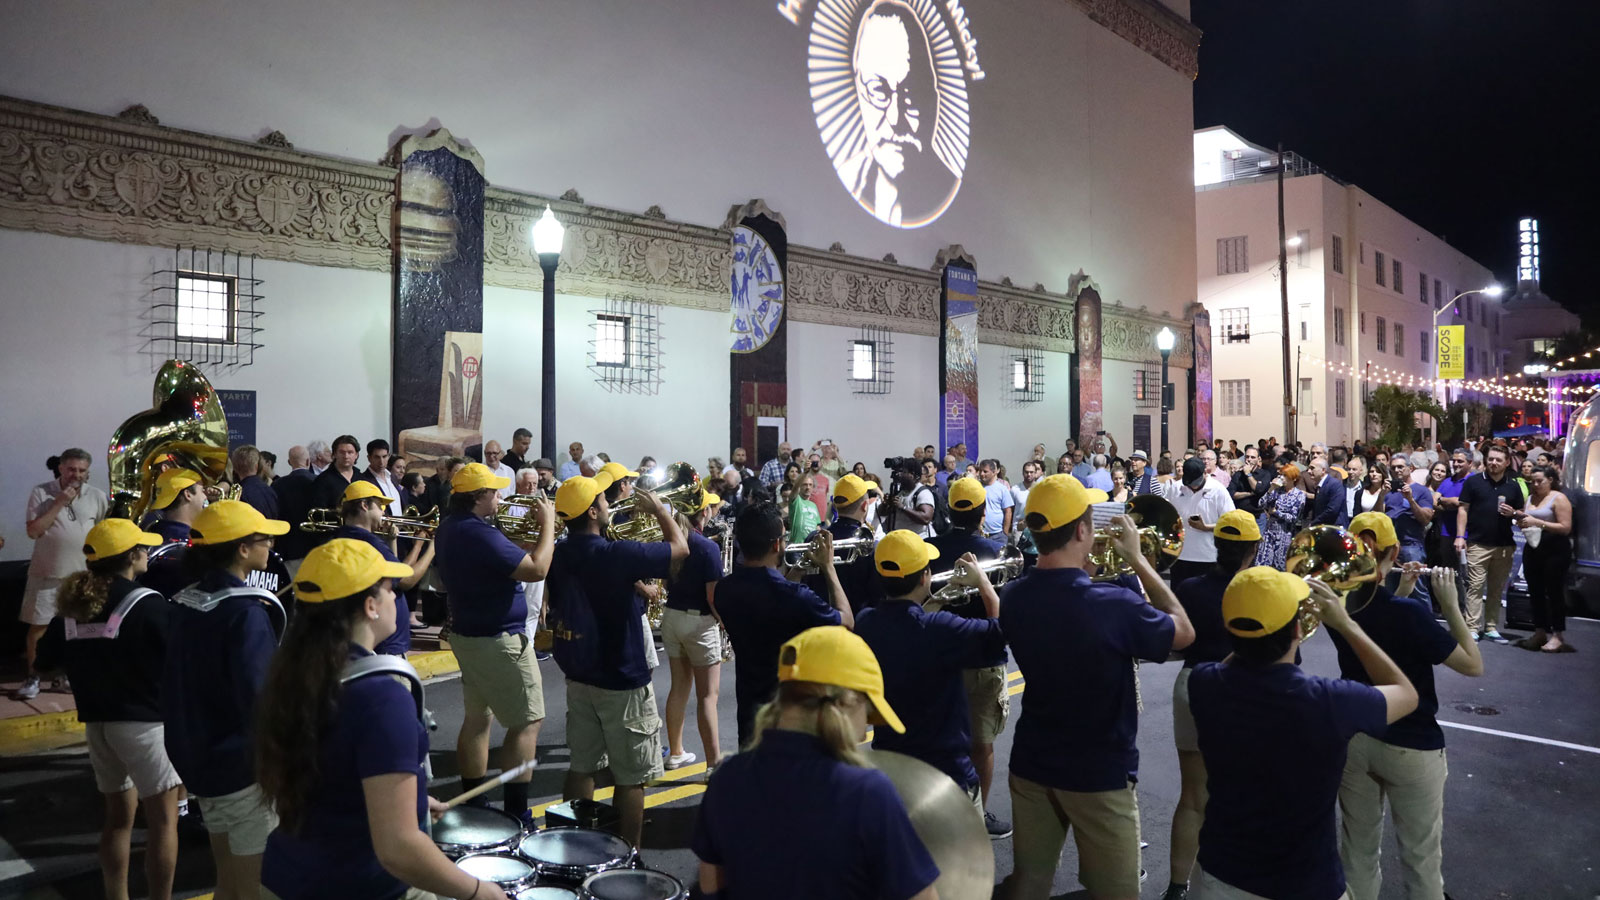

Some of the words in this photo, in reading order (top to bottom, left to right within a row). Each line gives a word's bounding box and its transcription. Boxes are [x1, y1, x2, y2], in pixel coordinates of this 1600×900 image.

[1519, 218, 1532, 280] ESSEX
[1440, 329, 1450, 369] SCOPE
[243, 569, 279, 591] AMAHA
